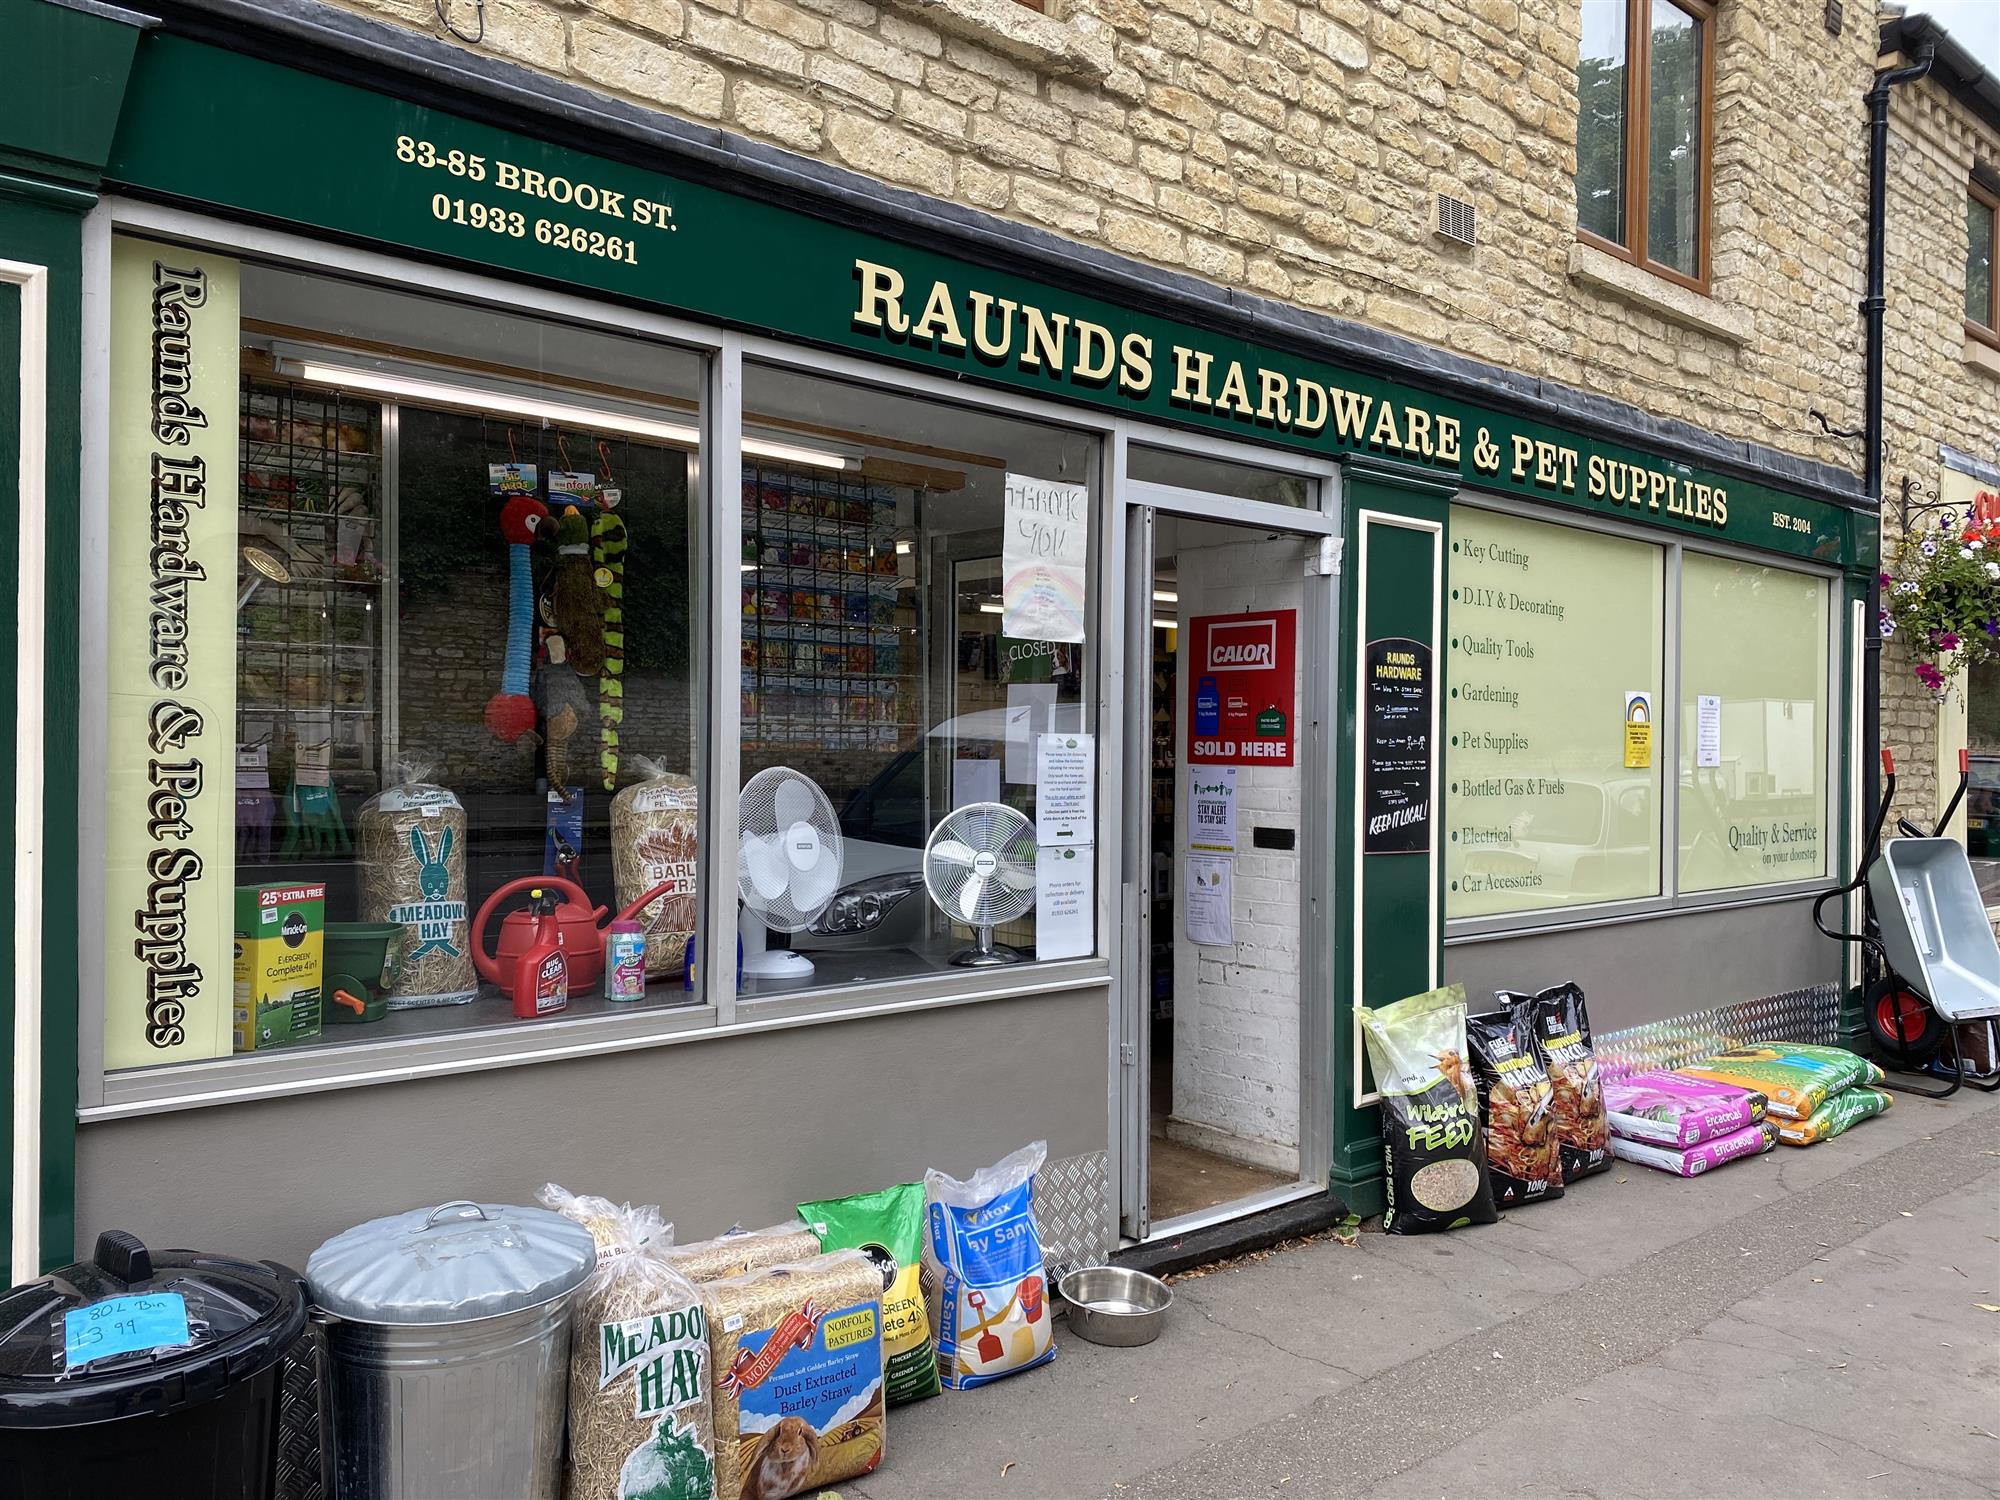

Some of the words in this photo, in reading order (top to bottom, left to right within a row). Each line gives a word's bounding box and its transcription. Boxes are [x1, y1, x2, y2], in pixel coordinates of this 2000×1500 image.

[396, 135, 486, 182] 83-85
[495, 161, 626, 219] BROOK
[633, 199, 678, 232] ST.
[432, 194, 526, 238] 01933
[535, 218, 638, 266] 626261
[150, 260, 208, 447] Raunds
[852, 258, 1154, 396] RAUNDS
[1171, 344, 1461, 465] HARDWARE
[1473, 427, 1500, 470] &
[1511, 434, 1578, 490] PET
[1588, 455, 1728, 526] SUPPLIES
[1005, 484, 1079, 522] THANK
[1772, 511, 1791, 531] EST.
[1793, 516, 1811, 534] 2004
[1018, 519, 1066, 557] YOU
[1463, 538, 1485, 563] Key
[1489, 543, 1529, 571] Cutting
[147, 451, 208, 691] Hardware
[1463, 587, 1494, 607] D.I.Y
[1497, 591, 1506, 609] &
[1509, 593, 1565, 621] Decorating
[1008, 640, 1056, 661] CLOSED
[1212, 644, 1272, 666] CALOR
[1386, 652, 1415, 665] RAUNDS
[1462, 635, 1503, 660] Quality
[1506, 639, 1534, 658] Tools
[1376, 665, 1422, 681] HARDWARE
[1462, 682, 1519, 708] Gardening
[148, 699, 204, 755] &
[1194, 741, 1236, 756] SOLD
[1241, 742, 1287, 758] HERE
[1462, 732, 1481, 749] Pet
[1484, 732, 1529, 754] Supplies
[1462, 779, 1501, 797] Bottled
[1504, 779, 1524, 796] Gas
[1526, 779, 1535, 796] &
[1538, 779, 1565, 795] Fuels
[147, 758, 204, 842] Pet
[1197, 804, 1210, 815] STAY
[1211, 805, 1227, 815] ALERT
[1203, 815, 1215, 824] STAY
[1215, 816, 1227, 825] SAFE
[1369, 813, 1391, 835] KEEP
[1392, 810, 1400, 829] IT
[1400, 799, 1428, 827] LOCAL!
[1462, 826, 1513, 845] Electrical
[1728, 825, 1769, 851] Quality
[1771, 823, 1780, 844] &
[1782, 822, 1817, 843] Service
[1762, 854, 1772, 865] on
[1772, 853, 1789, 867] your
[1790, 848, 1817, 863] doorstep
[652, 863, 696, 880] BARL
[1462, 875, 1482, 893] Car
[1485, 871, 1543, 891] Accessories
[282, 890, 305, 901] EXTRA
[306, 888, 324, 898] FREE
[659, 879, 696, 894] TRA
[400, 903, 464, 923] MEADOW
[281, 924, 307, 936] Miracle-Gro
[421, 922, 449, 939] HAY
[135, 848, 204, 1049] Supplies
[266, 963, 302, 977] Complete
[541, 963, 563, 979] CLEAR
[545, 957, 559, 969] BUG
[1488, 1037, 1509, 1050] FUEL
[1705, 1111, 1743, 1127] Ericaceous
[1406, 1118, 1474, 1150] FEED
[1712, 1134, 1754, 1157] Ericaceous
[1384, 1144, 1393, 1175] WILD
[966, 1202, 1011, 1225] Vitax
[970, 1235, 989, 1252] ay
[994, 1222, 1027, 1244] San
[597, 1247, 615, 1261] MAL
[871, 1257, 898, 1272] le-Gro
[943, 1275, 955, 1295] ay
[134, 1299, 167, 1312] Bin
[883, 1297, 917, 1316] GREEN
[828, 1312, 871, 1332] NORFOLK
[943, 1299, 955, 1342] Sand
[828, 1327, 873, 1347] PASTURES
[746, 1353, 774, 1385] MORE
[768, 1372, 795, 1383] Premium
[795, 1366, 806, 1376] Soft
[806, 1362, 827, 1372] Golden
[827, 1357, 845, 1368] Barley
[845, 1352, 859, 1361] Straw
[892, 1352, 912, 1364] THICKER
[639, 1349, 701, 1413] HAY
[774, 1382, 802, 1400] Dust
[805, 1363, 857, 1389] Extracted
[891, 1366, 914, 1379] GREENER
[900, 1378, 917, 1390] WEEDS
[780, 1395, 820, 1415] Barley
[821, 1384, 853, 1403] Straw
